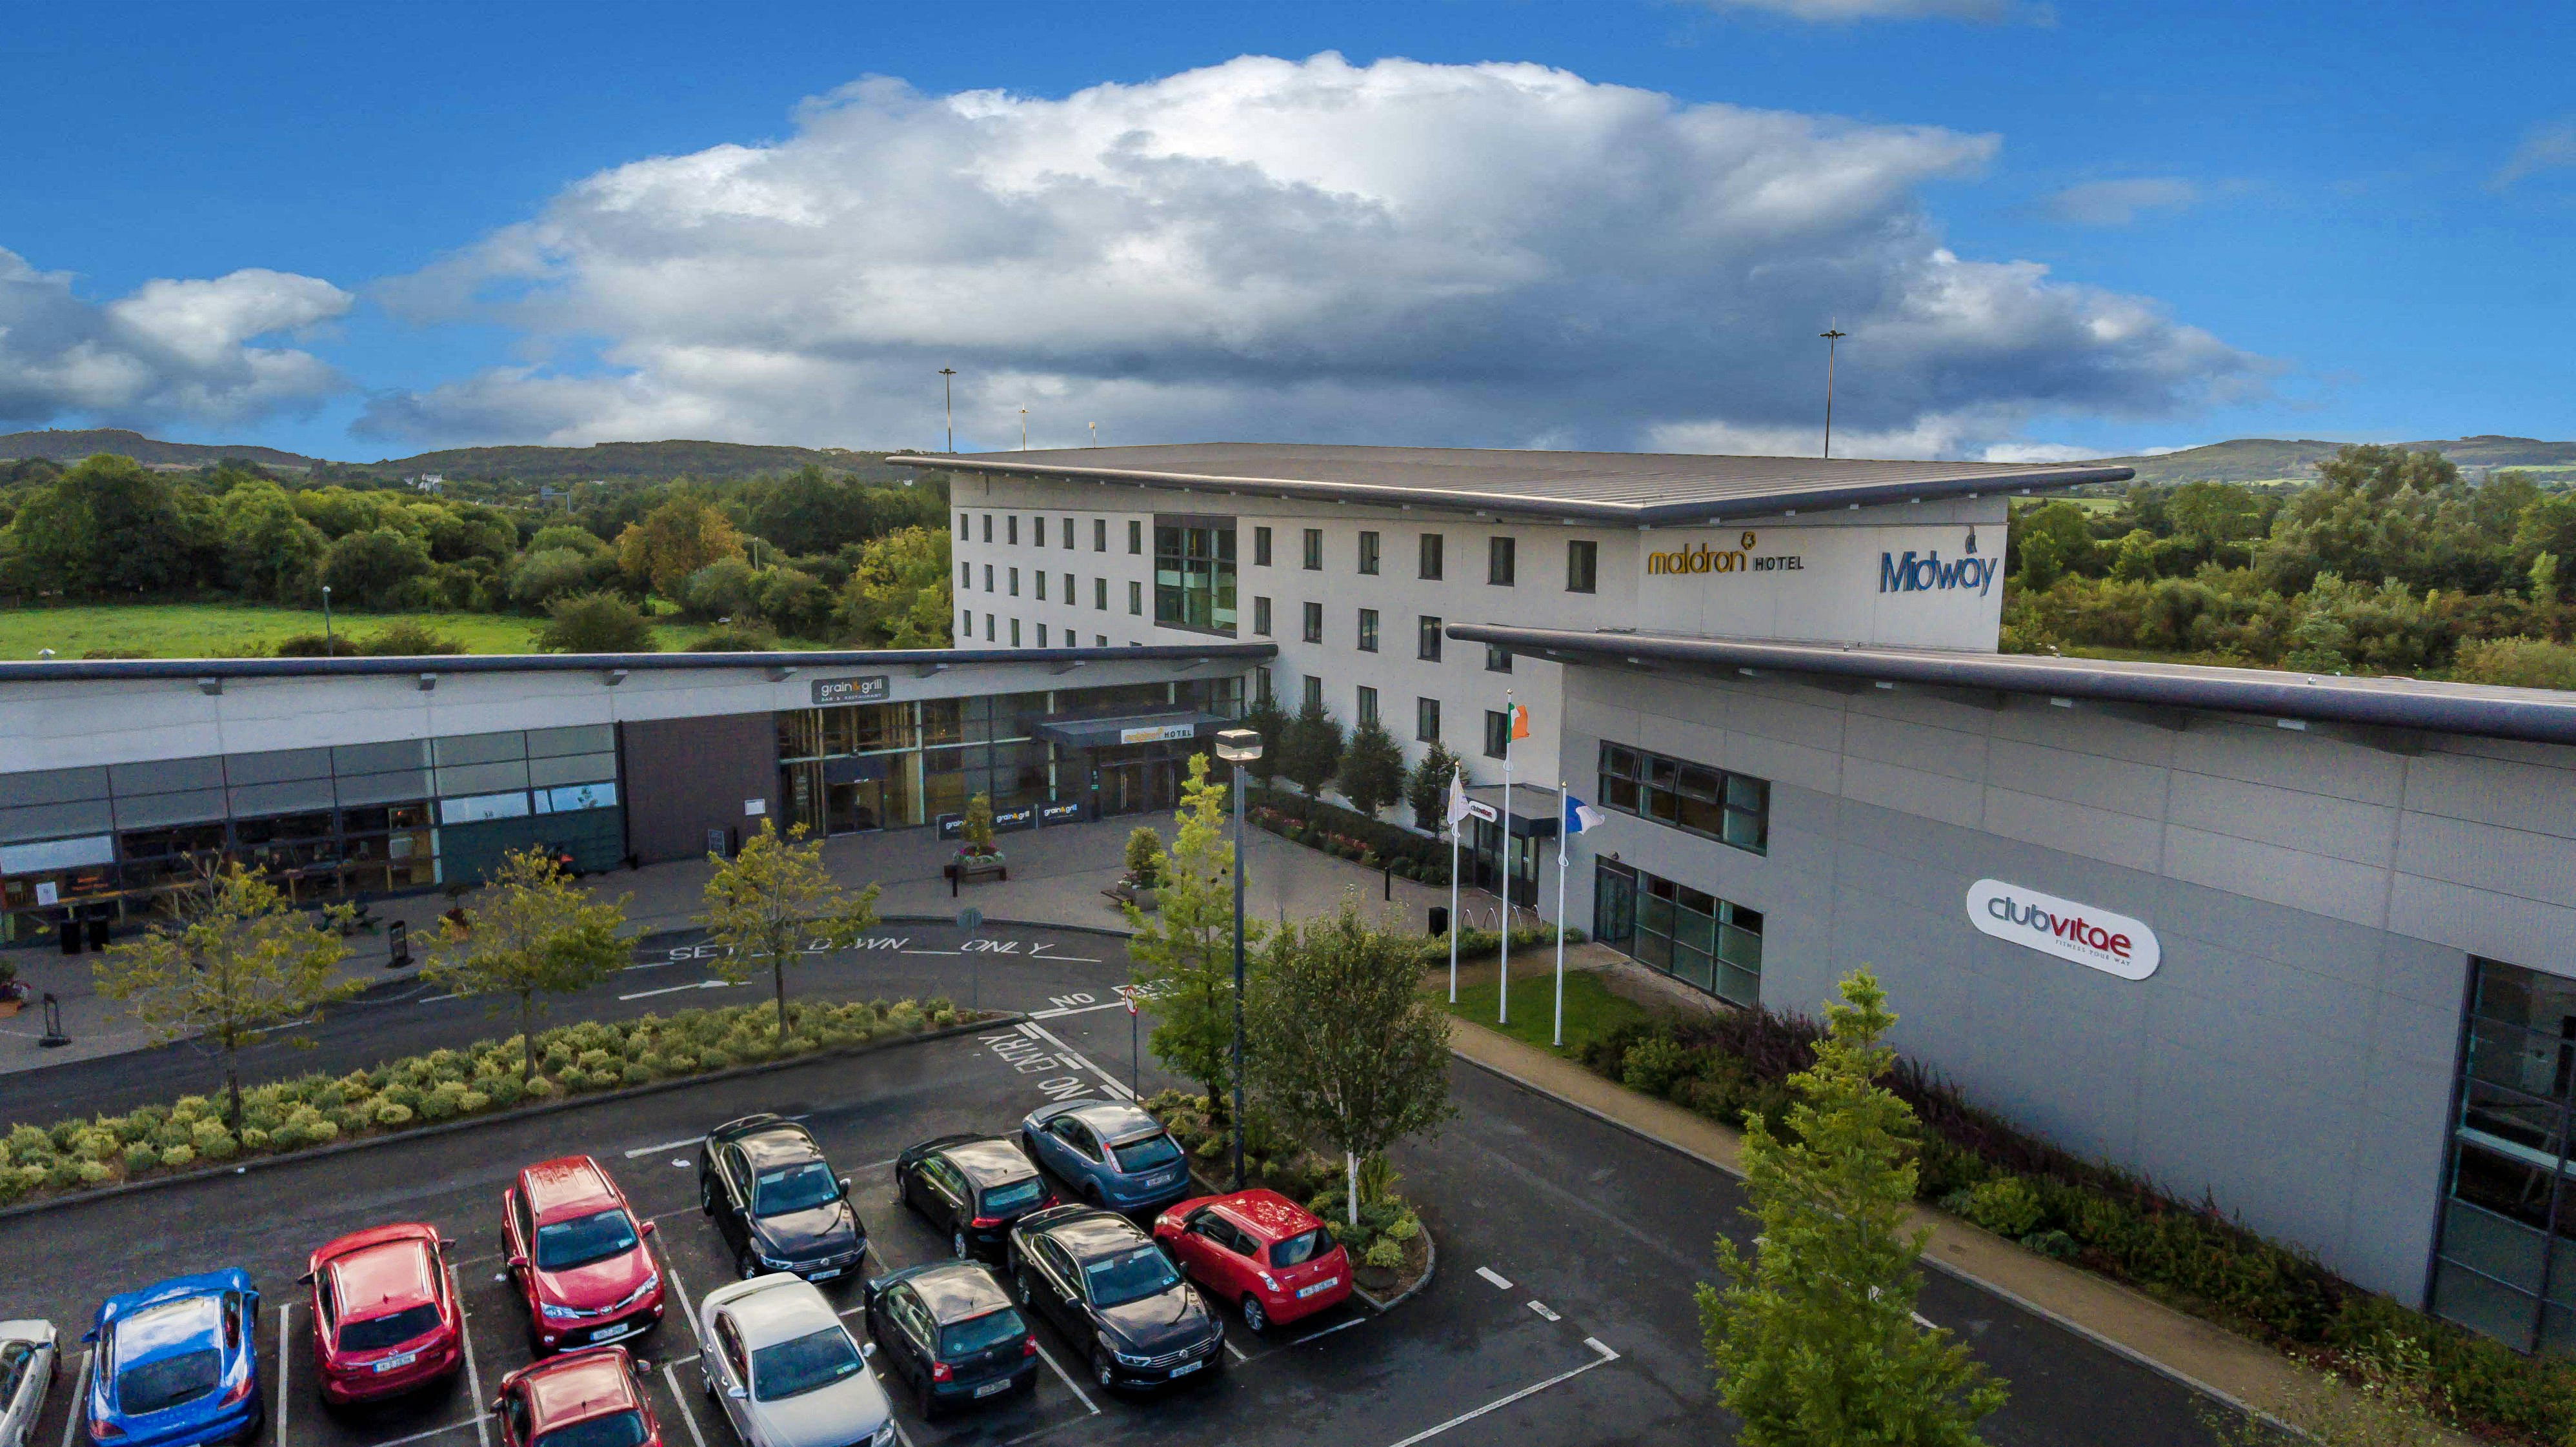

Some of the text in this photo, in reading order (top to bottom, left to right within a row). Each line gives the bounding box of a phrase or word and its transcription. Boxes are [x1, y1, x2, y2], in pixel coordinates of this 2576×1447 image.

[1647, 543, 1804, 574] maldron HOTEL
[1880, 550, 1998, 598] Midway
[1164, 729, 1192, 738] HOTEL
[1987, 896, 2132, 958] clubvitae
[808, 938, 910, 951] DWN
[960, 940, 1056, 955] ONLY
[2055, 939, 2131, 966] FITNESS YOUR WAY
[1048, 993, 1096, 1008] NO
[978, 1033, 1095, 1101] NO ENTRY
